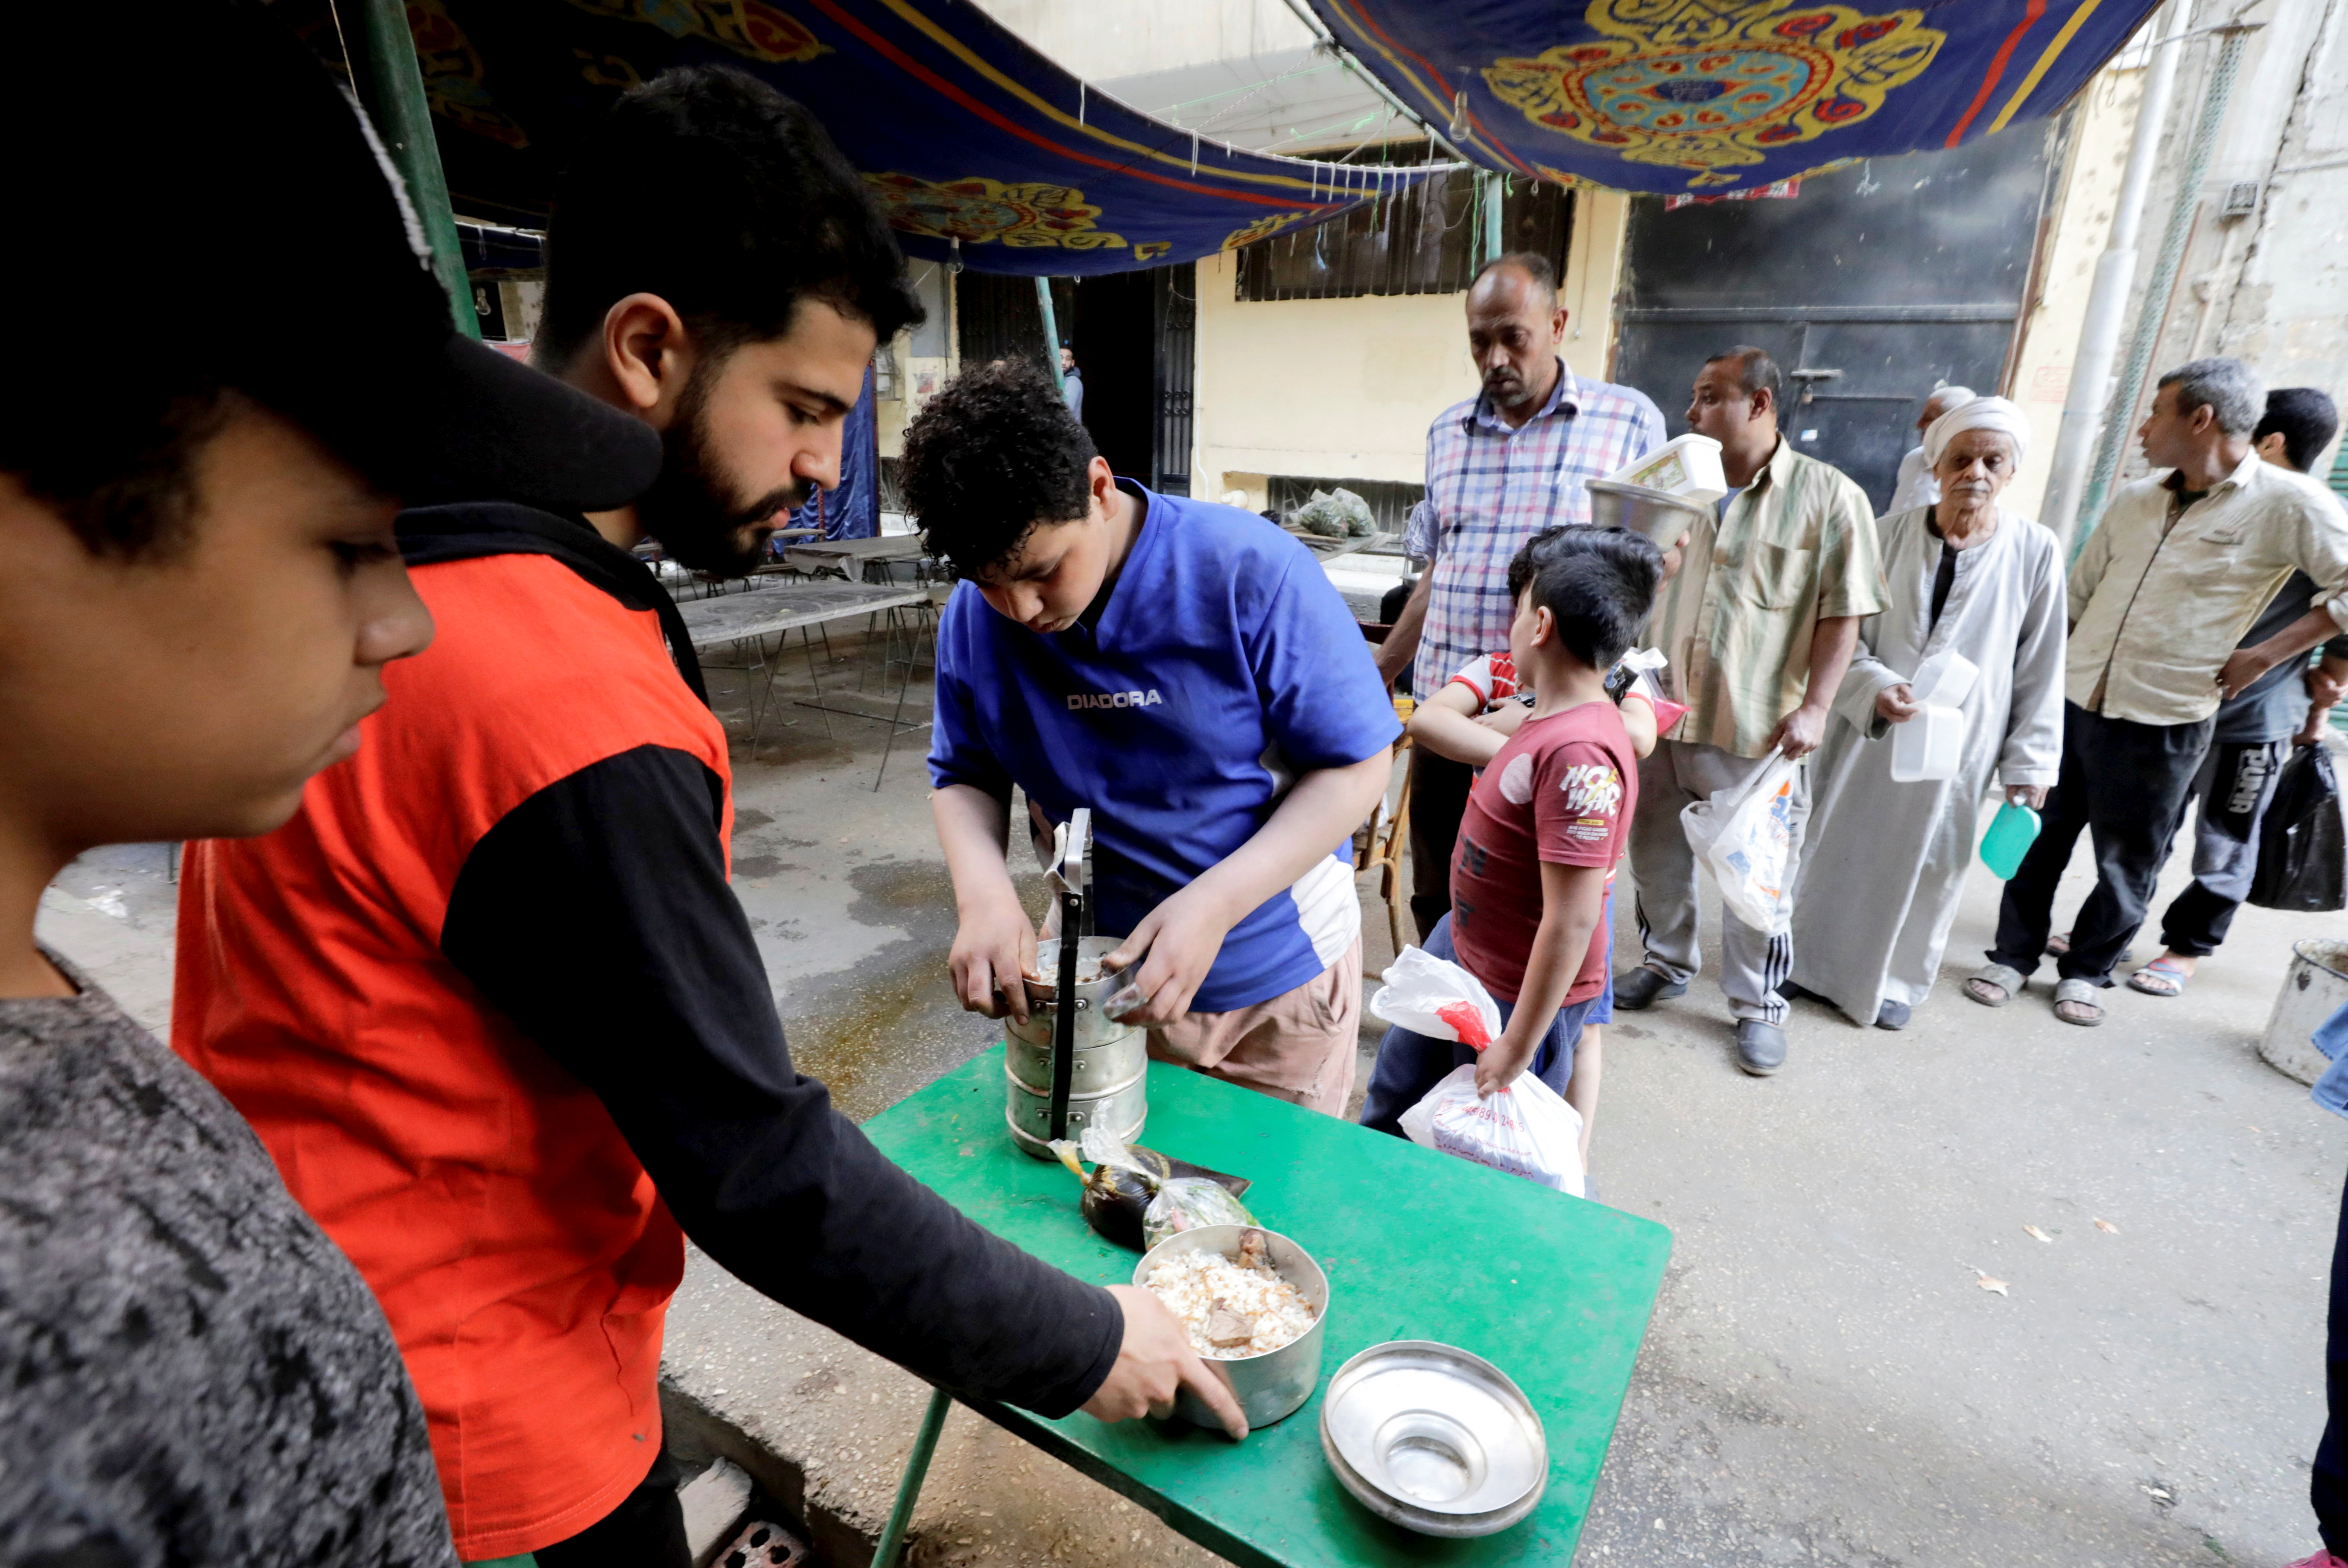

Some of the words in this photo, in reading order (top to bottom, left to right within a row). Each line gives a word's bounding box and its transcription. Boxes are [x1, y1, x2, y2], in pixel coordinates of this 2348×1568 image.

[1067, 689, 1162, 710] DIADORA
[1559, 764, 1611, 791] NO
[2228, 743, 2270, 814] PUMA
[1565, 783, 1621, 817] WAR
